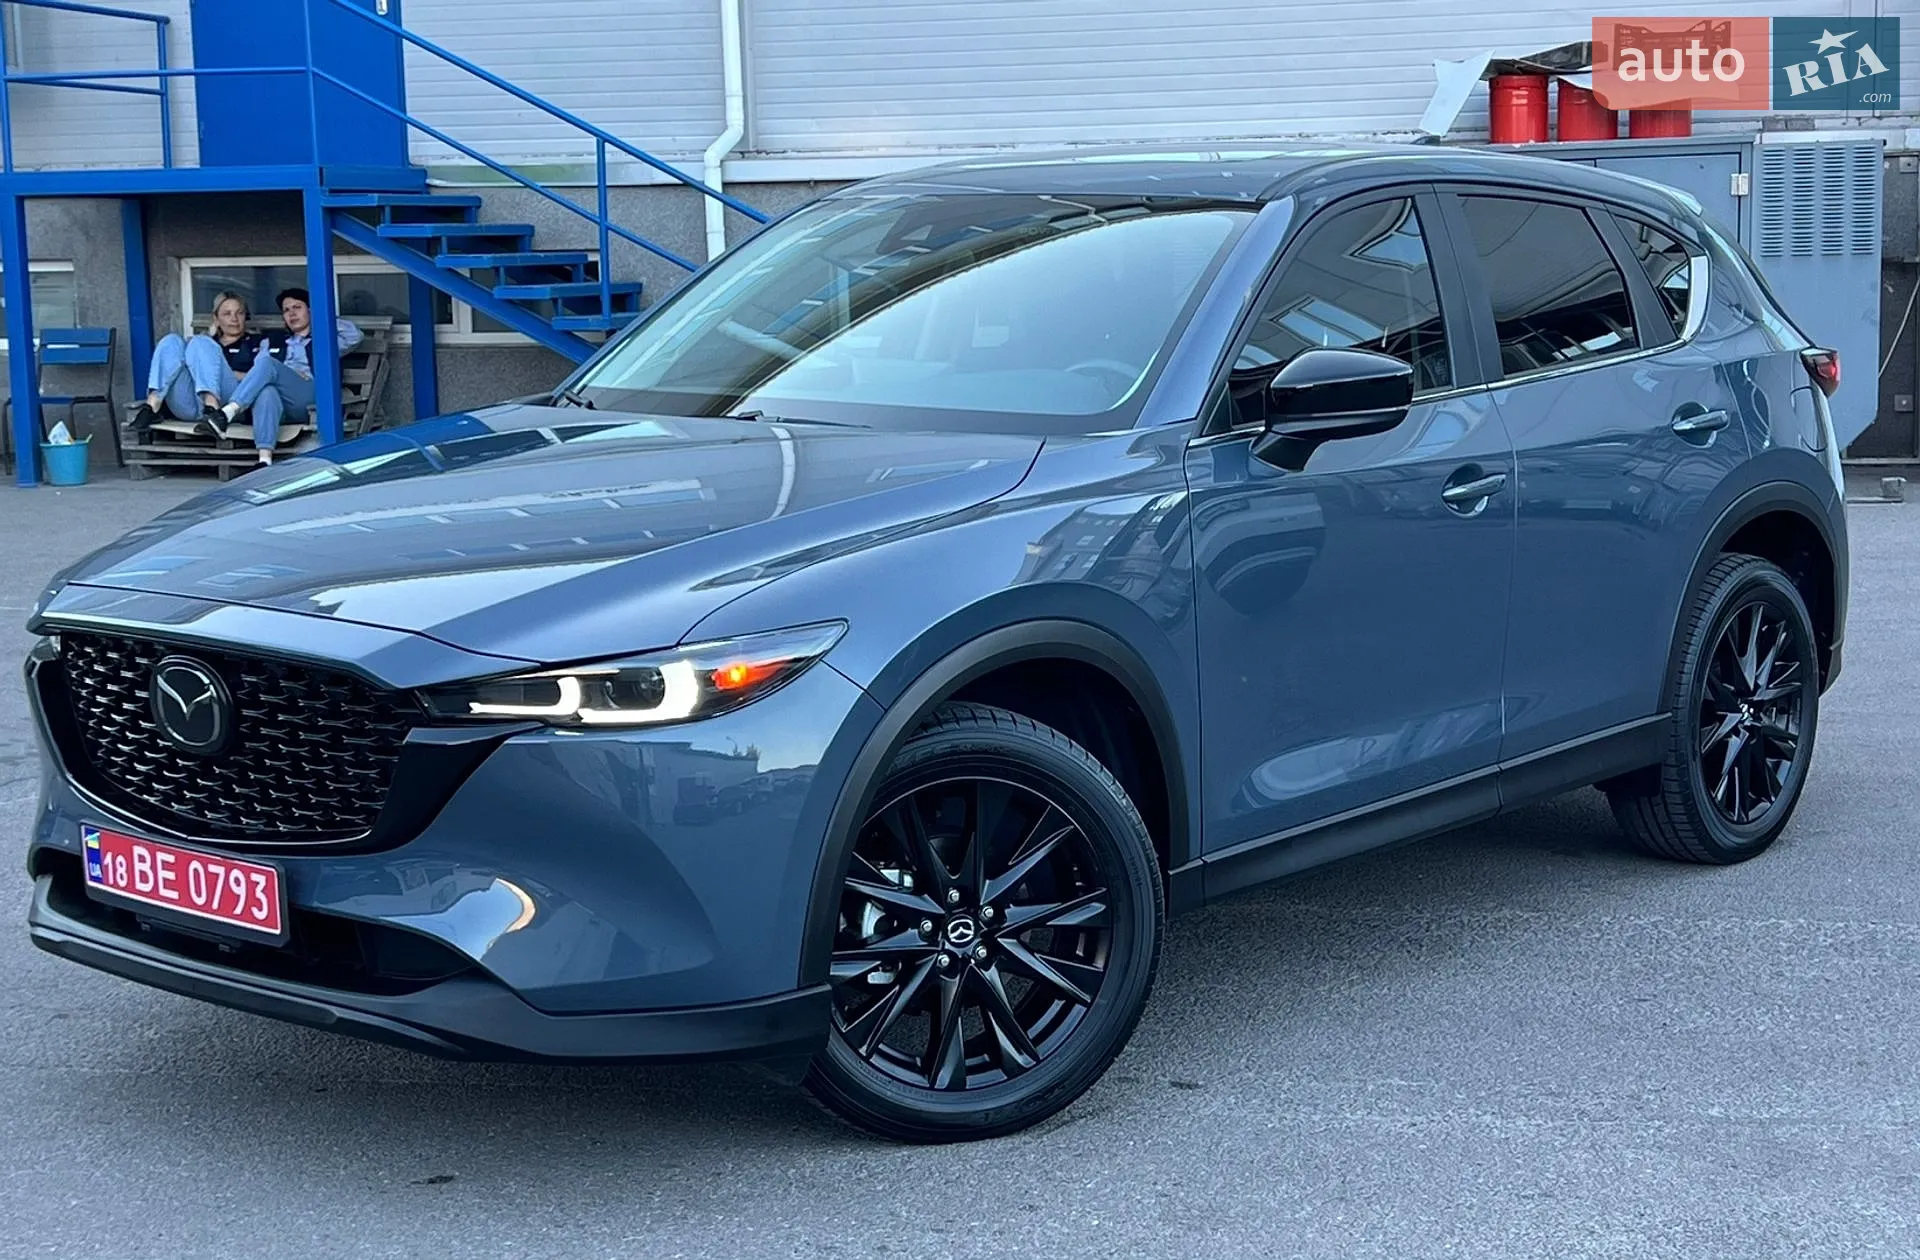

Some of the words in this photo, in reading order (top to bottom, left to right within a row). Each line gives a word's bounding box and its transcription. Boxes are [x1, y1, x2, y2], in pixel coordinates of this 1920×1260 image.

[104, 851, 128, 888] 18
[132, 845, 180, 900] BE
[188, 860, 269, 920] 0793
